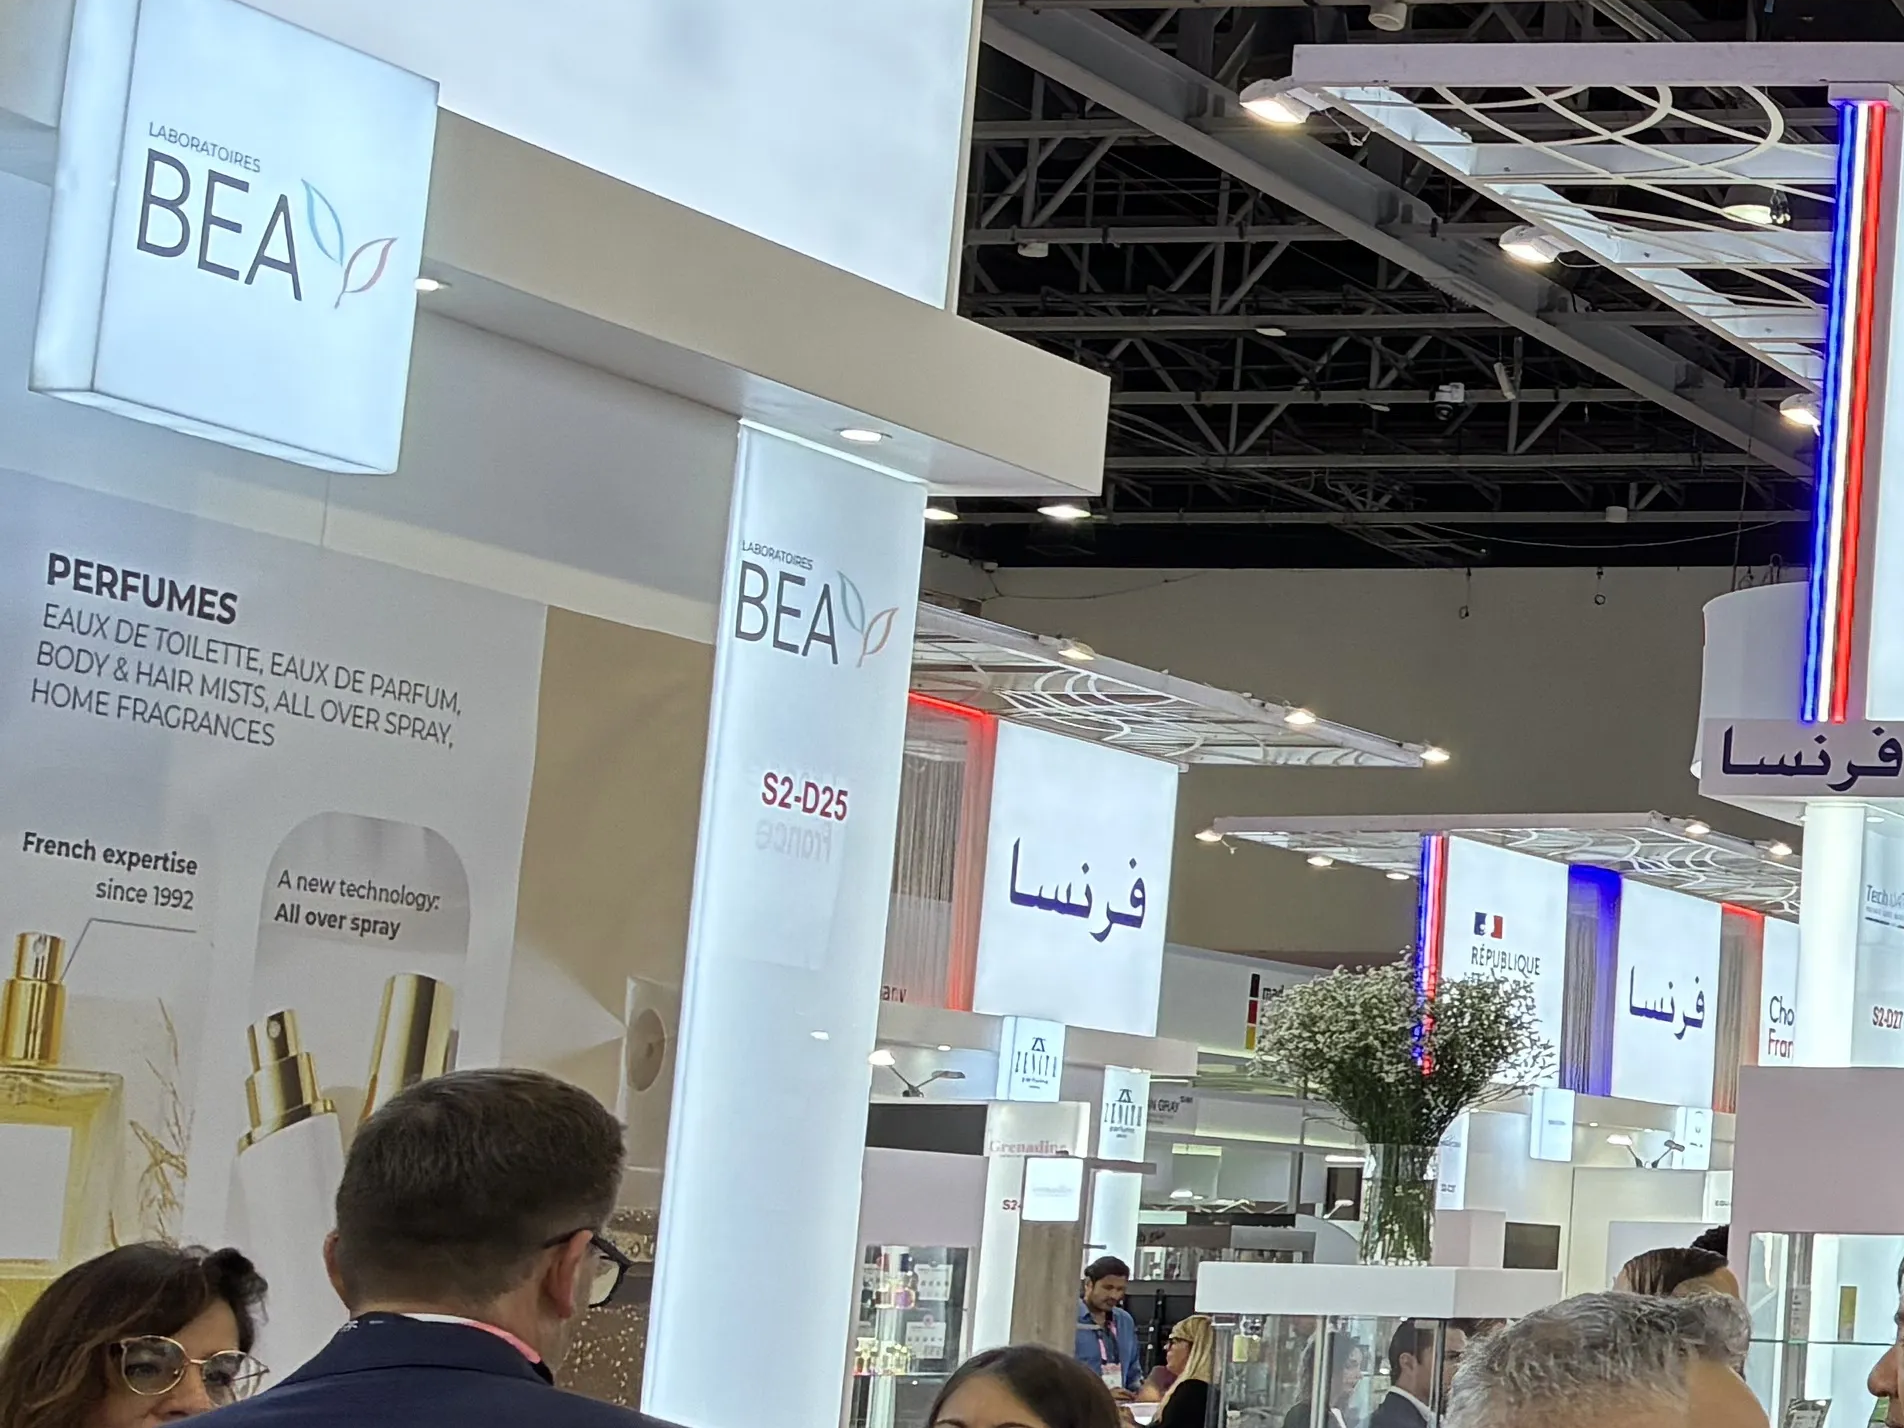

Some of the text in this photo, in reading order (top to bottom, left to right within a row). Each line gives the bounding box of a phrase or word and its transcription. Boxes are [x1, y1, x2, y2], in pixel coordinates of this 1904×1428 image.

[148, 120, 261, 174] LABORATOIRES
[136, 147, 302, 302] BEA
[46, 552, 238, 626] PERFUMES
[733, 561, 839, 666] BEA
[43, 603, 463, 717] EAUX DE TOILETTE, EAUX DE PARFUM,
[31, 678, 275, 747] HOME FRAGRANCES
[36, 640, 455, 749] BODY & HAIR MISTS, ALL OVER SPRAY,
[1720, 724, 1904, 792] فرنسا
[762, 772, 848, 821] S2-D25
[22, 831, 198, 880] French expertise
[96, 879, 195, 911] since 1992
[277, 870, 441, 913] A new technology:
[1008, 836, 1147, 943] فرنسا
[274, 902, 401, 941] All over spray
[1471, 944, 1541, 978] RÉPUBLIQUE
[1628, 964, 1707, 1040] فرنسا
[1770, 996, 1794, 1026] Cho
[1872, 1006, 1903, 1029] S2-D27
[1768, 1028, 1793, 1058] Fran
